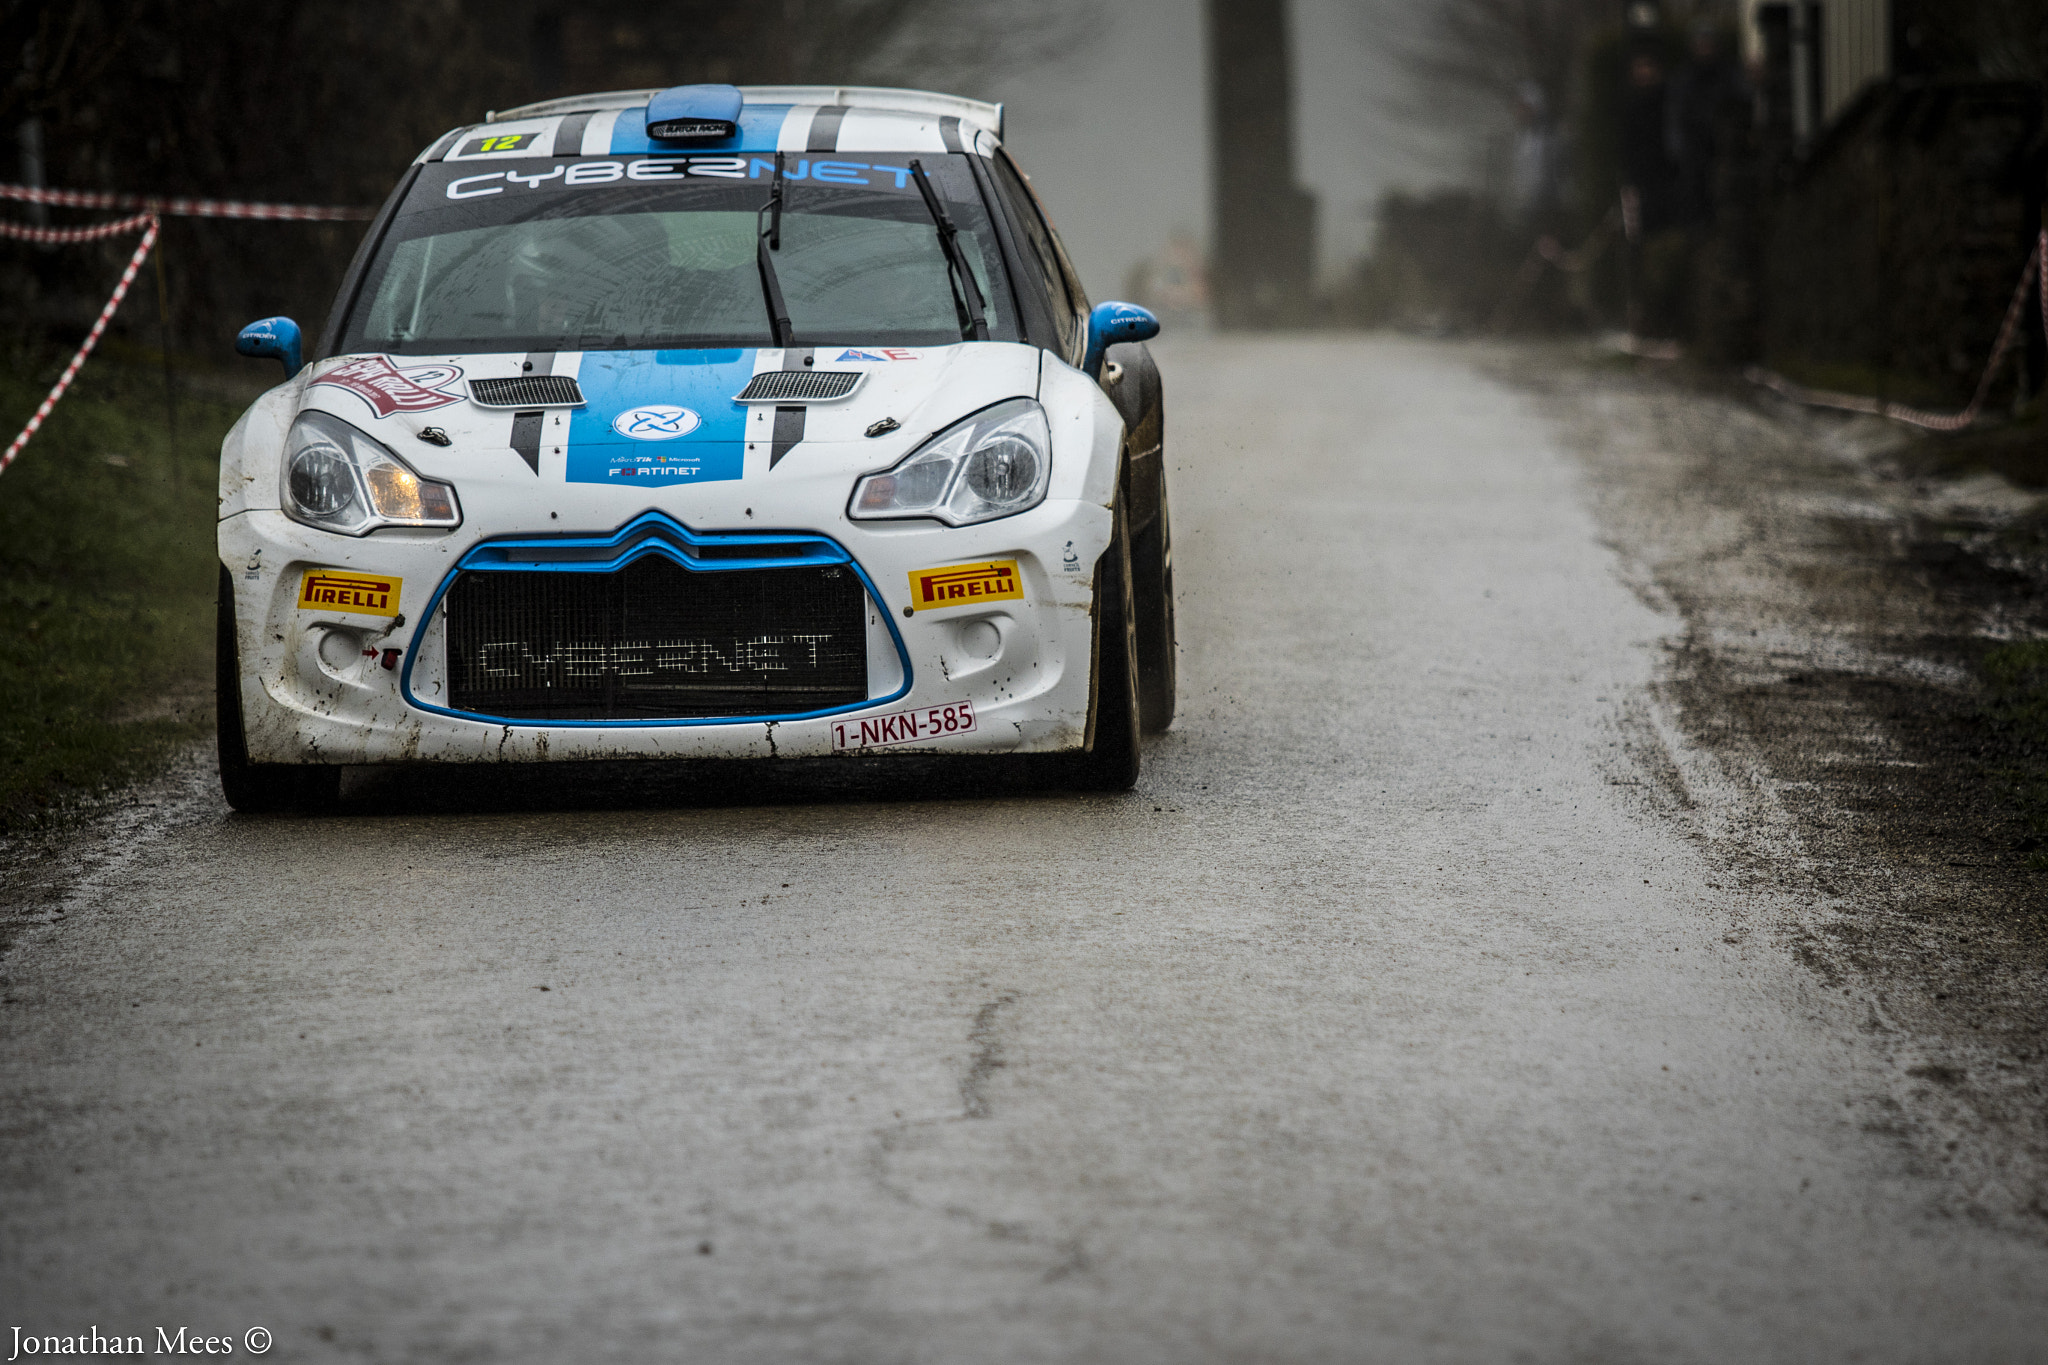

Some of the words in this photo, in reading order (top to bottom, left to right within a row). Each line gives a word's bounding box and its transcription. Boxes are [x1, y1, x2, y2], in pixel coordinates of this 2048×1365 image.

[480, 135, 522, 151] 12
[331, 359, 392, 381] SPA
[409, 370, 446, 383] 12
[368, 376, 446, 406] RALLY
[608, 467, 701, 477] FORTINET
[304, 577, 390, 609] PIRELLI
[920, 567, 1014, 602] PIRELLI
[835, 705, 973, 748] 1-NKN-585
